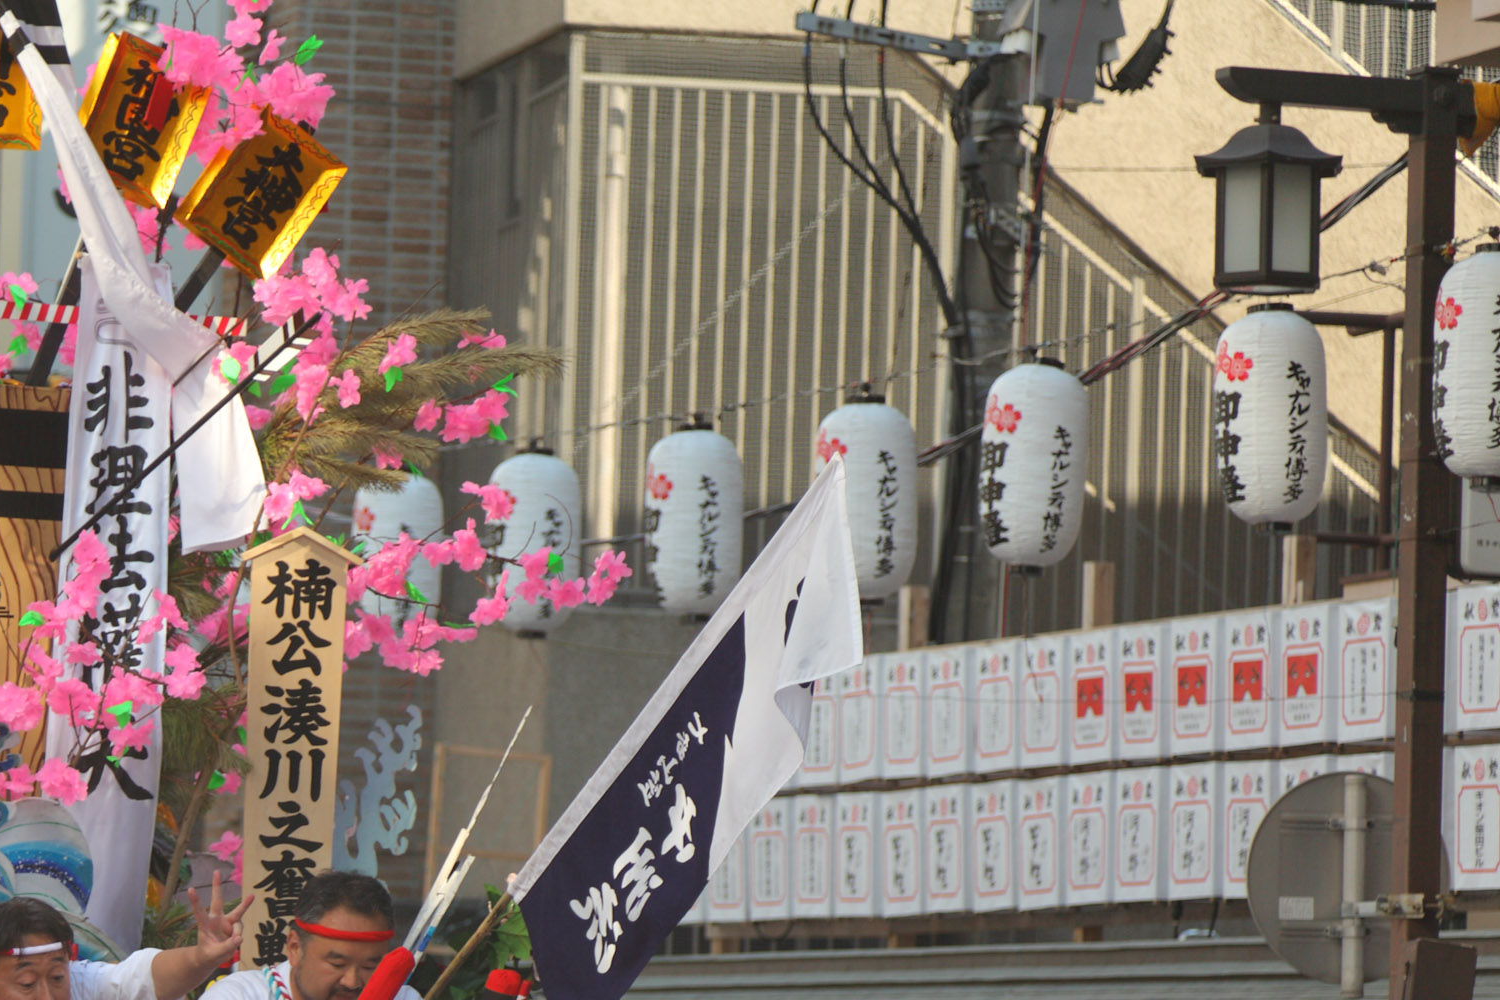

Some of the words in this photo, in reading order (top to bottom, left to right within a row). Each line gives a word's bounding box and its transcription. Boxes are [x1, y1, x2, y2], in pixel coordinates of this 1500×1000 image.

[1040, 425, 1073, 554] キャナルシティ博多
[1283, 360, 1311, 504] キャナルシティ博多
[874, 450, 901, 579] キャナルシティ博多
